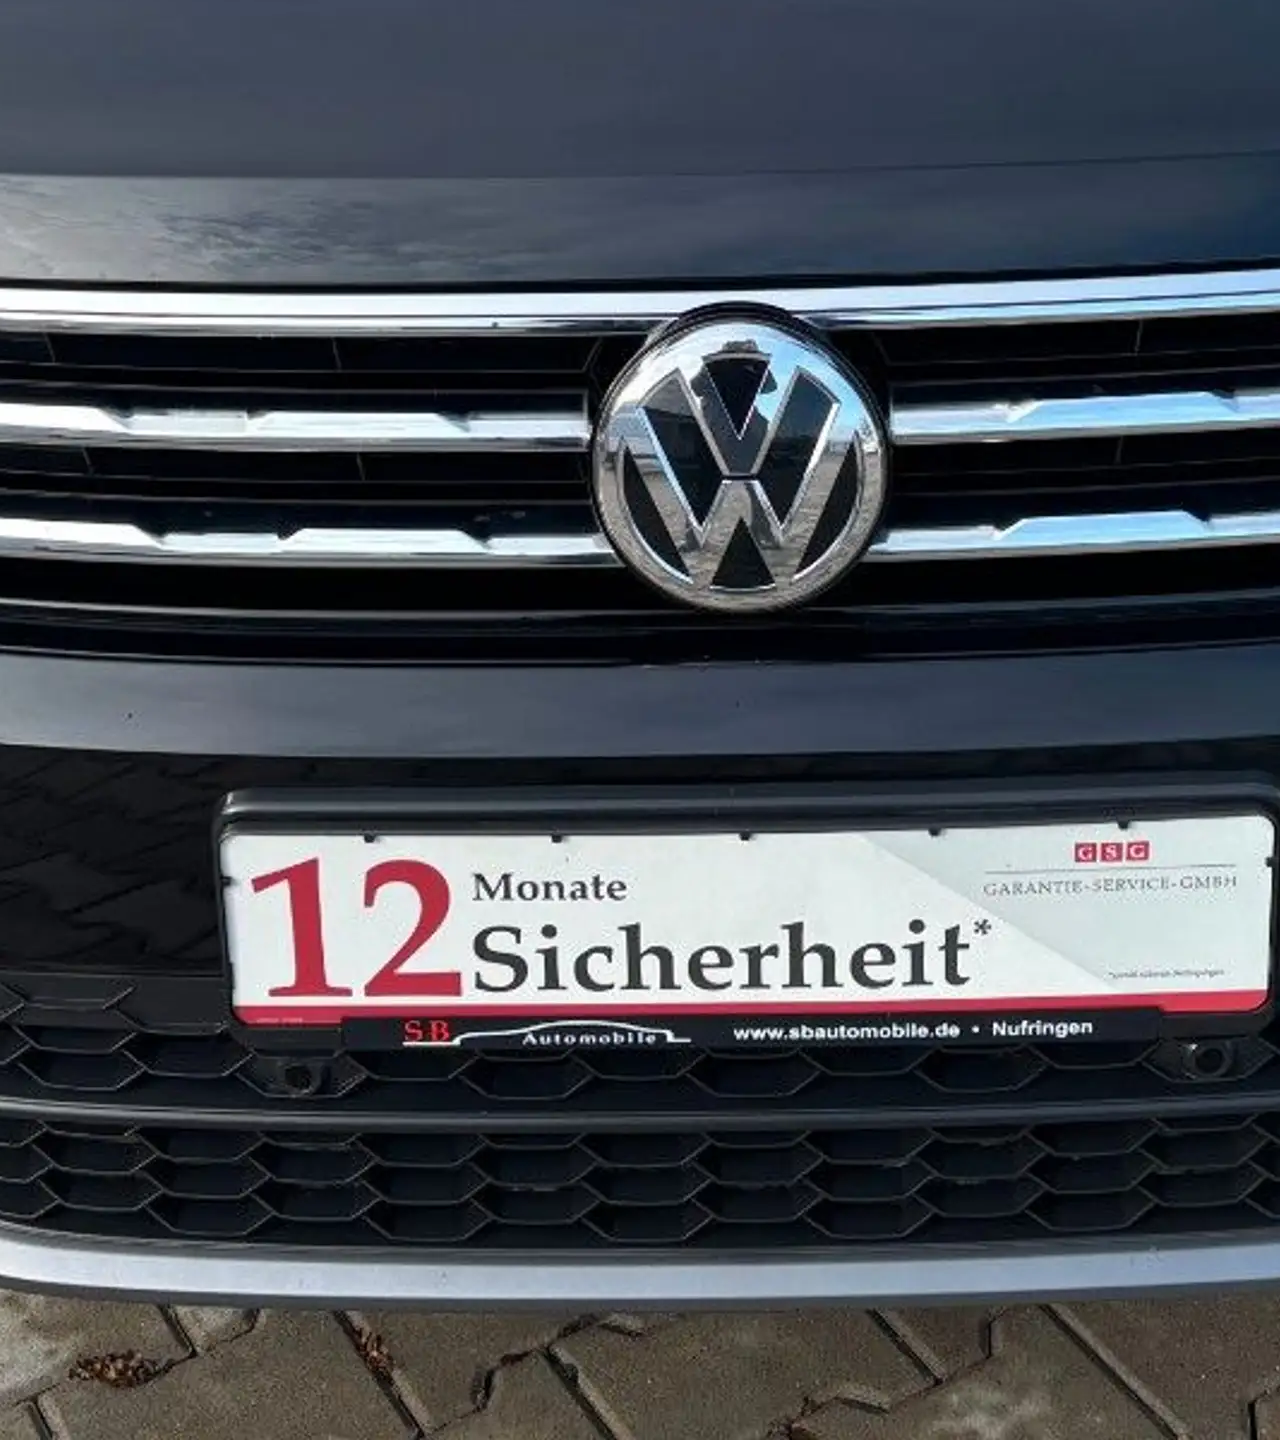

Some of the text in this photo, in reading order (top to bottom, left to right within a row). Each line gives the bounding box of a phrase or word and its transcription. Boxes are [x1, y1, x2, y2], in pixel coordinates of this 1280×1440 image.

[1074, 841, 1151, 863] GSG
[472, 873, 627, 902] Monate
[250, 858, 463, 998] 12
[404, 1020, 657, 1046] SB Automobile
[733, 1019, 1094, 1042] www.sbautomobile.de Nufringen
